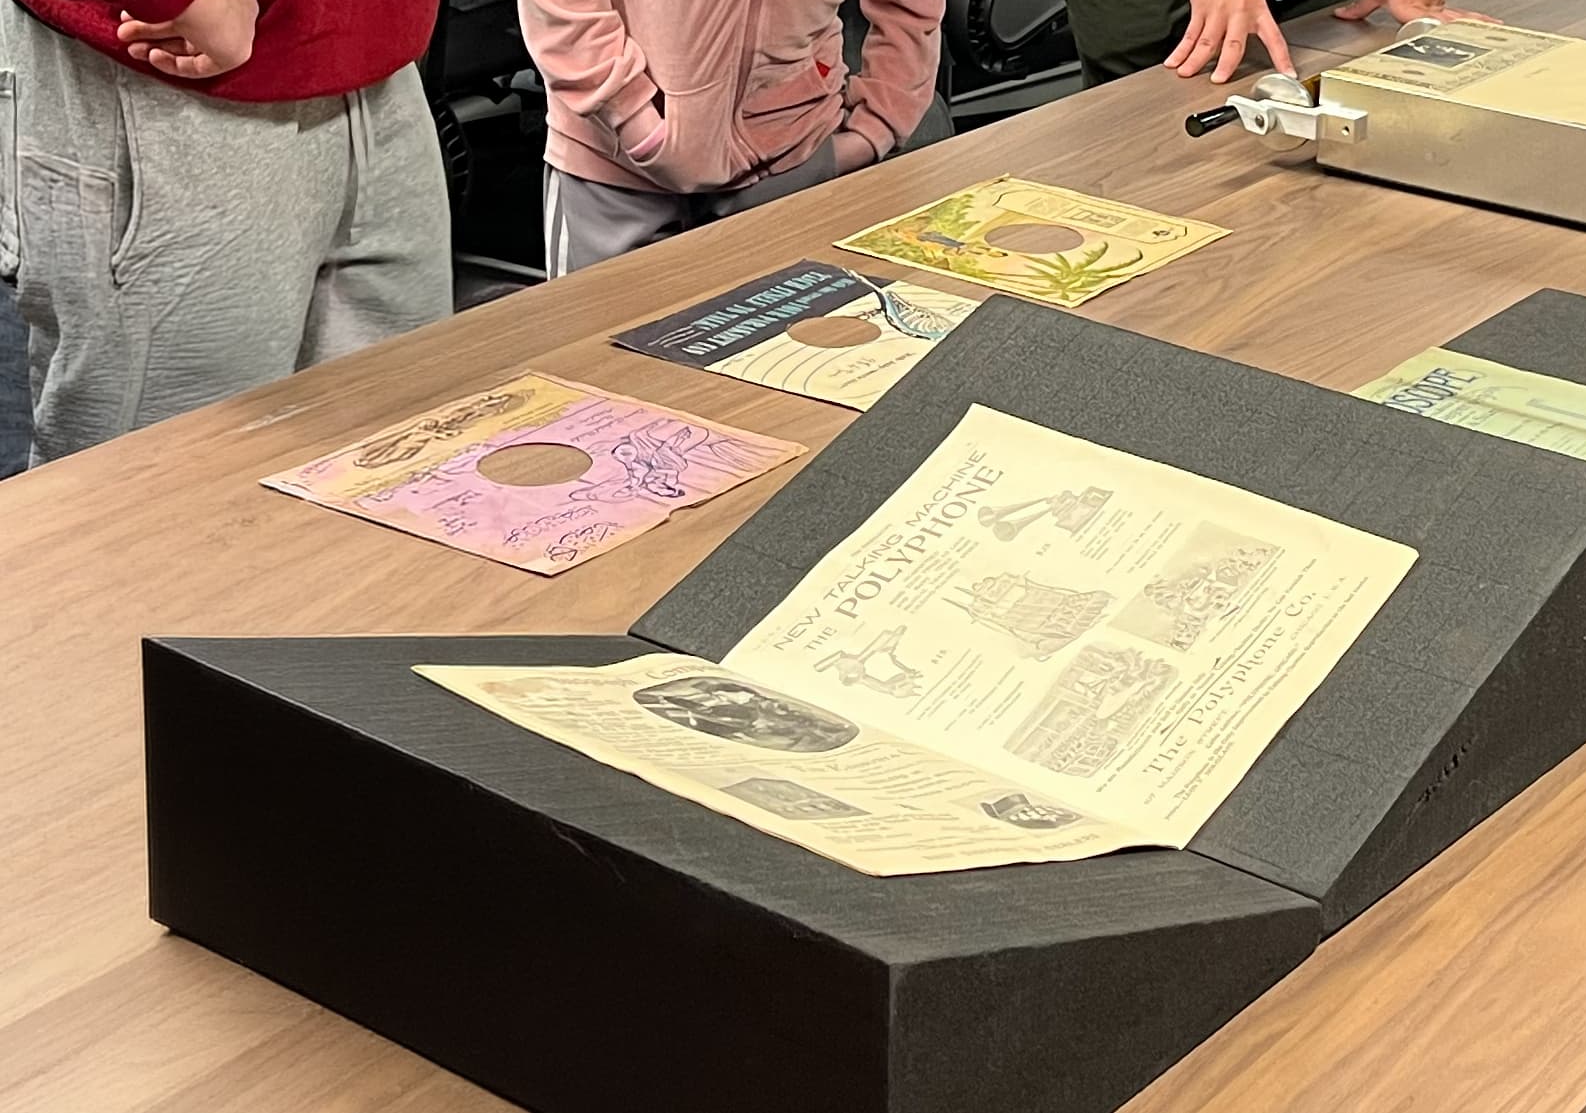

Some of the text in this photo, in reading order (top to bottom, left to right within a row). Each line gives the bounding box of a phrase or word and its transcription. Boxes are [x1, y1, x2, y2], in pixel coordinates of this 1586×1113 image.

[771, 606, 825, 651] NEW
[821, 531, 905, 603] TALKING
[903, 449, 987, 527] MACHINE
[803, 626, 838, 651] THE
[832, 464, 1005, 620] POLYPHONE
[1141, 732, 1189, 777] The
[1186, 625, 1287, 724] Polyphone
[1282, 589, 1317, 619] Co.
